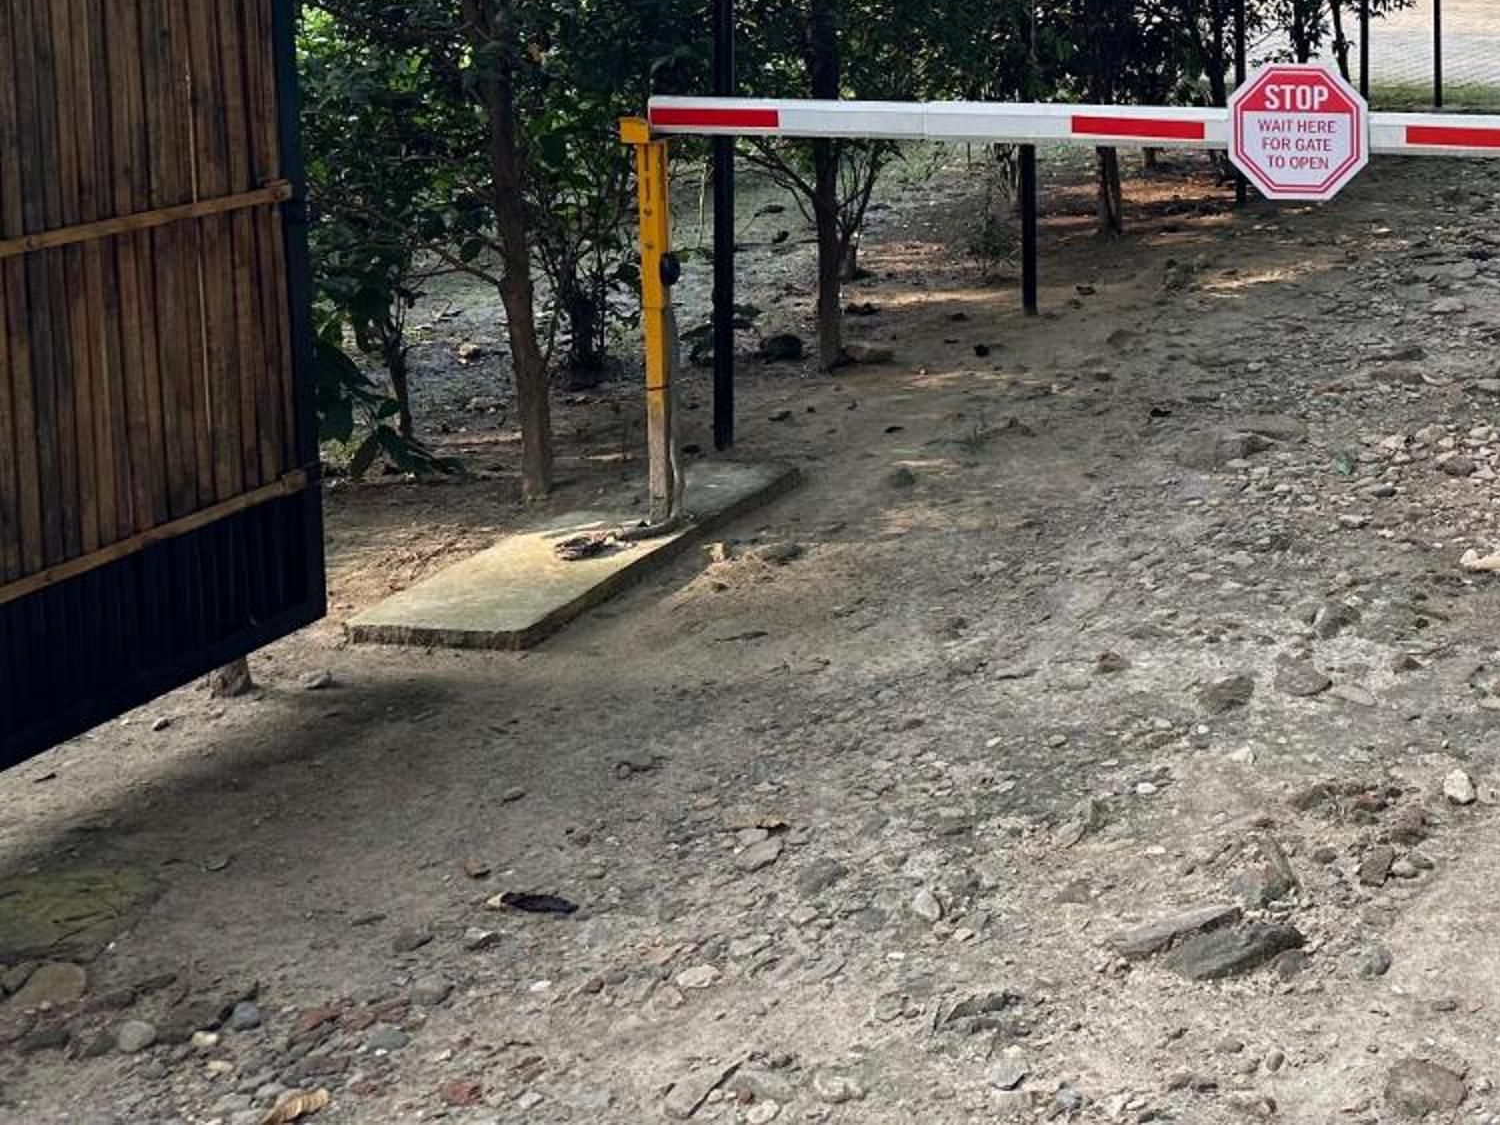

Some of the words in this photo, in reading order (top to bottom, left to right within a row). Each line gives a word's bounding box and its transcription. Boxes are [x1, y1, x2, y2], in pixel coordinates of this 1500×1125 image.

[1264, 85, 1329, 110] STOP
[1258, 119, 1293, 132] WAIT
[1297, 120, 1336, 134] HERE
[1261, 137, 1291, 151] FOR
[1295, 138, 1332, 152] GATE
[1268, 155, 1285, 168] TO
[1289, 156, 1329, 170] OPEN
